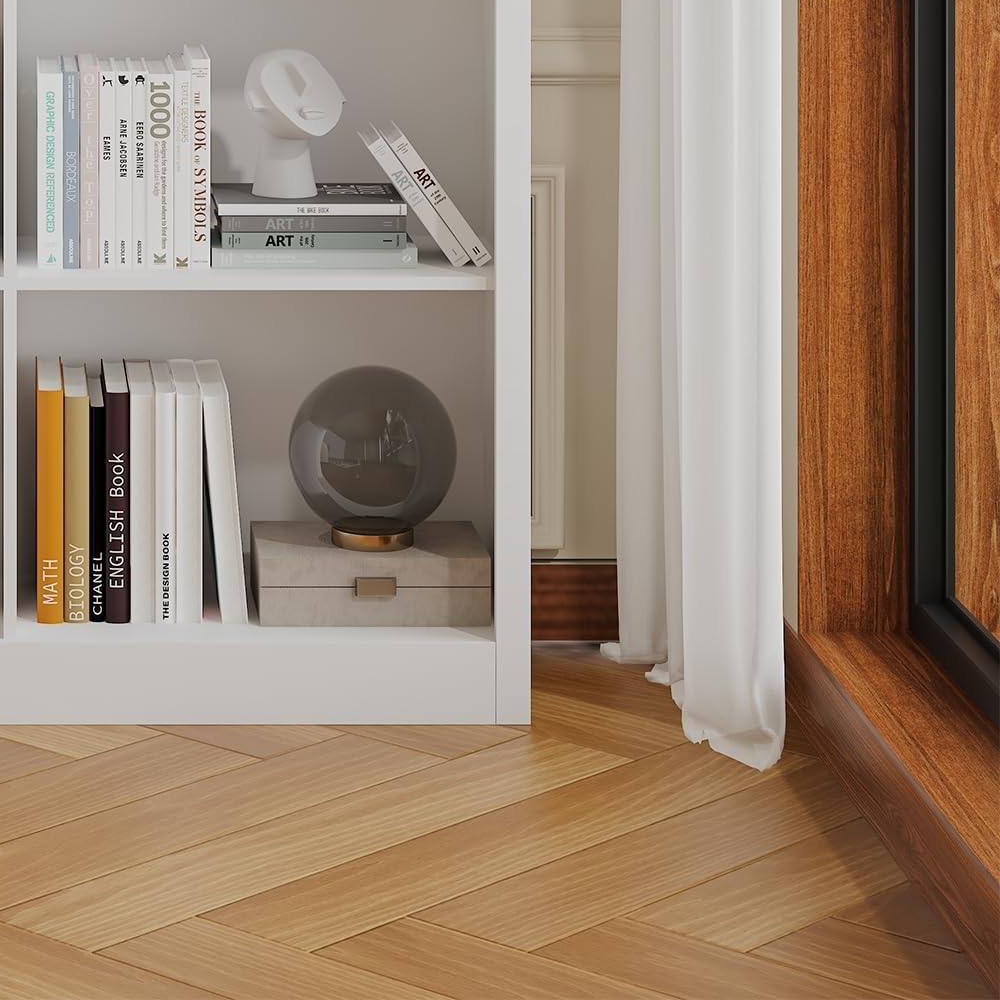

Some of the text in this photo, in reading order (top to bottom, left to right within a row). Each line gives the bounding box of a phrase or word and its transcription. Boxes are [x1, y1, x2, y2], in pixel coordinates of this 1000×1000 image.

[149, 80, 171, 139] 1000
[194, 110, 206, 151] BOOK
[46, 91, 56, 233] GRAPHIC DESIGN REFERENCED
[66, 152, 77, 201] BORDEAUX
[102, 136, 111, 161] EAMES
[119, 119, 128, 178] ARNE JACOBSEN
[135, 120, 144, 179] EERO SAARINEN
[194, 168, 206, 242] SYMBOLS
[413, 168, 436, 189] ART
[265, 235, 294, 247] ART
[109, 453, 124, 588] ENGLISH Book
[43, 560, 58, 604] MATH
[68, 544, 84, 622] BIOLOGY
[92, 552, 103, 616] CHANEL
[162, 533, 171, 620] THE DESIGN BOOK
